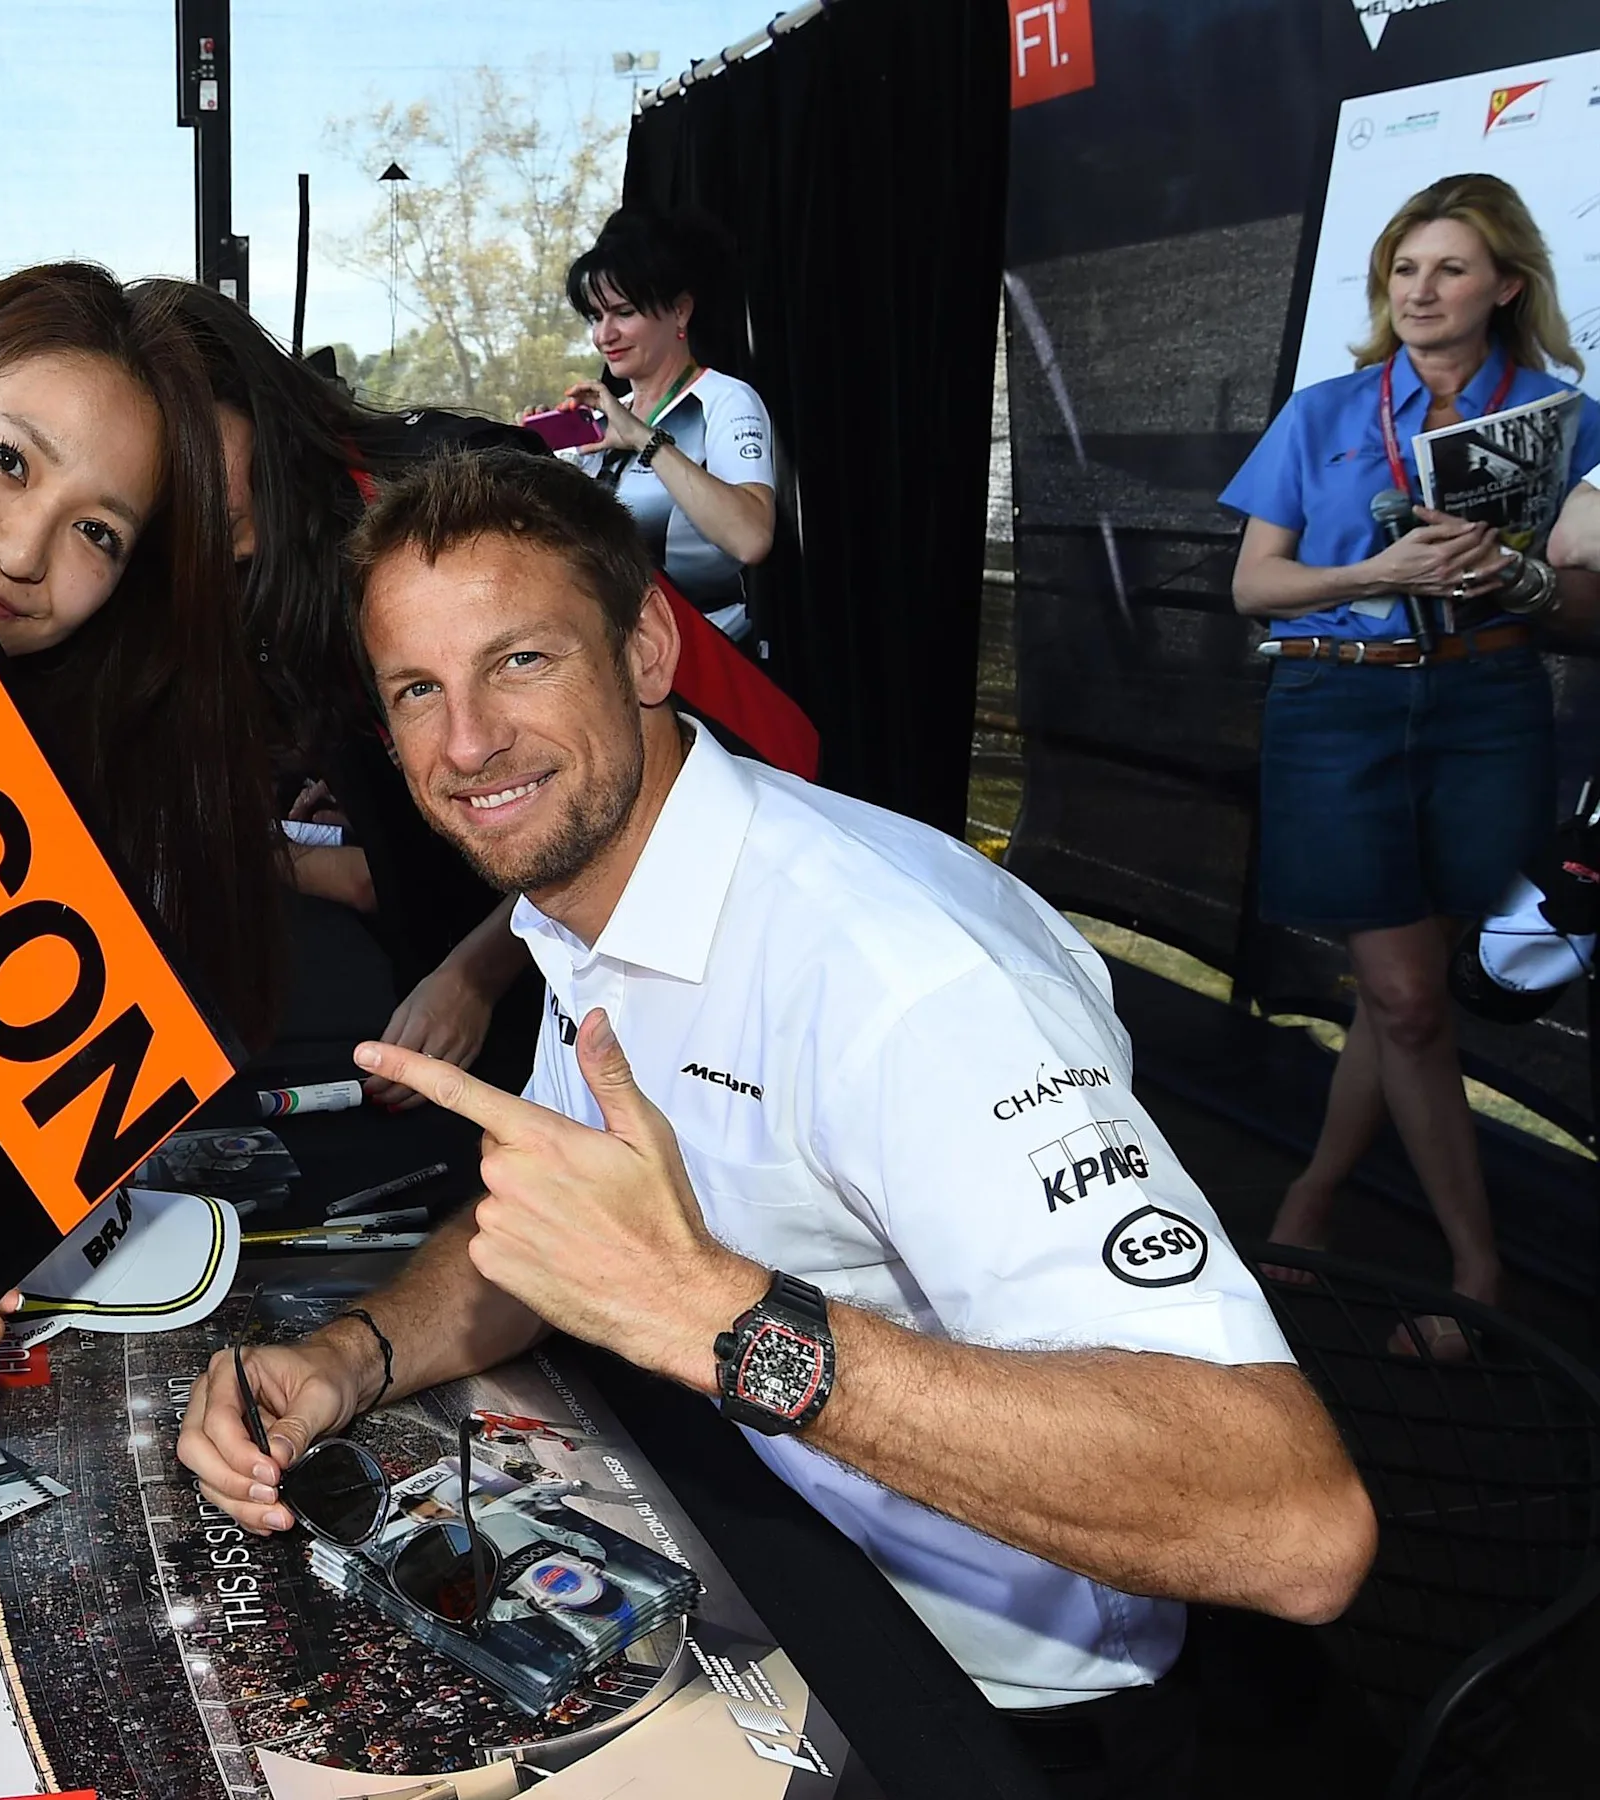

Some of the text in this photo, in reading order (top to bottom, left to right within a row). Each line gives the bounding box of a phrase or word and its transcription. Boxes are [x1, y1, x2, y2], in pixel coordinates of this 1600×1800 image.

[993, 1064, 1112, 1121] CHANDON
[409, 1470, 448, 1494] HONDA
[210, 1547, 251, 1570] IS
[216, 1574, 267, 1633] THIS
[730, 1673, 754, 1702] GRAND
